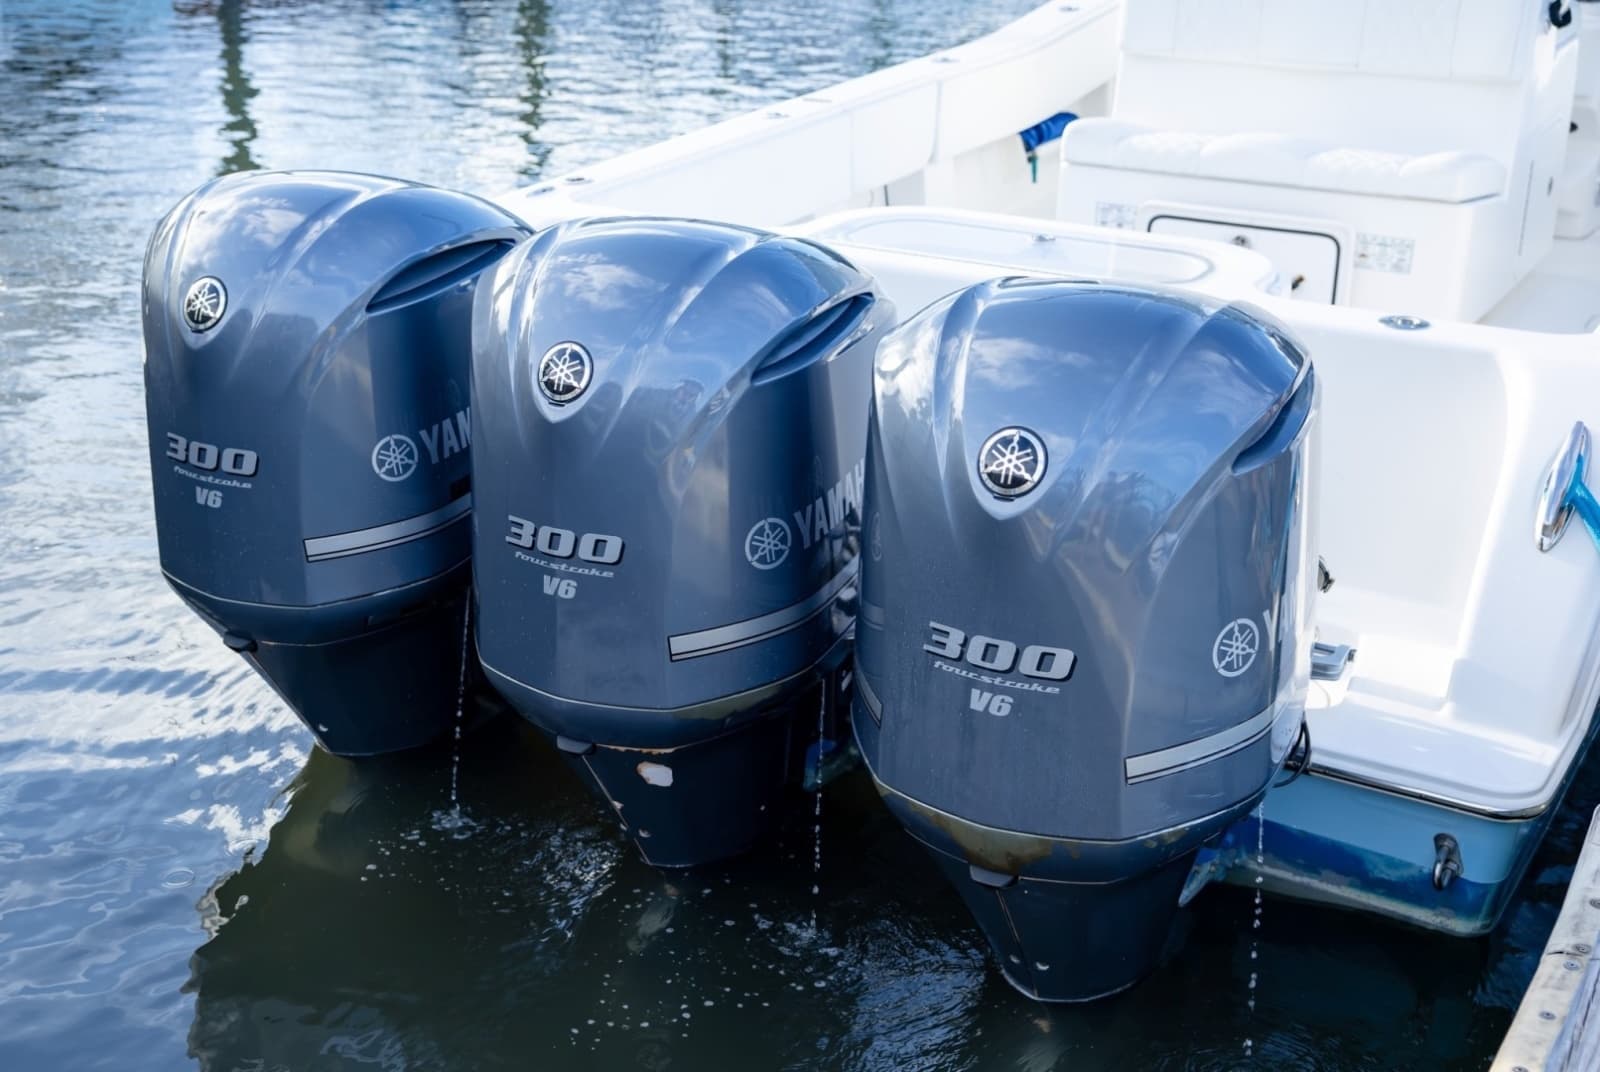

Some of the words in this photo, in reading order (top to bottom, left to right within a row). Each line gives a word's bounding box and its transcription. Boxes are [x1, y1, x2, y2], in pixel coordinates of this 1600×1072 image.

[166, 432, 258, 476] 300
[195, 486, 223, 509] V6
[505, 514, 624, 564] 300
[543, 574, 578, 599] V6
[923, 620, 1077, 681] 300
[969, 687, 1014, 717] V6
